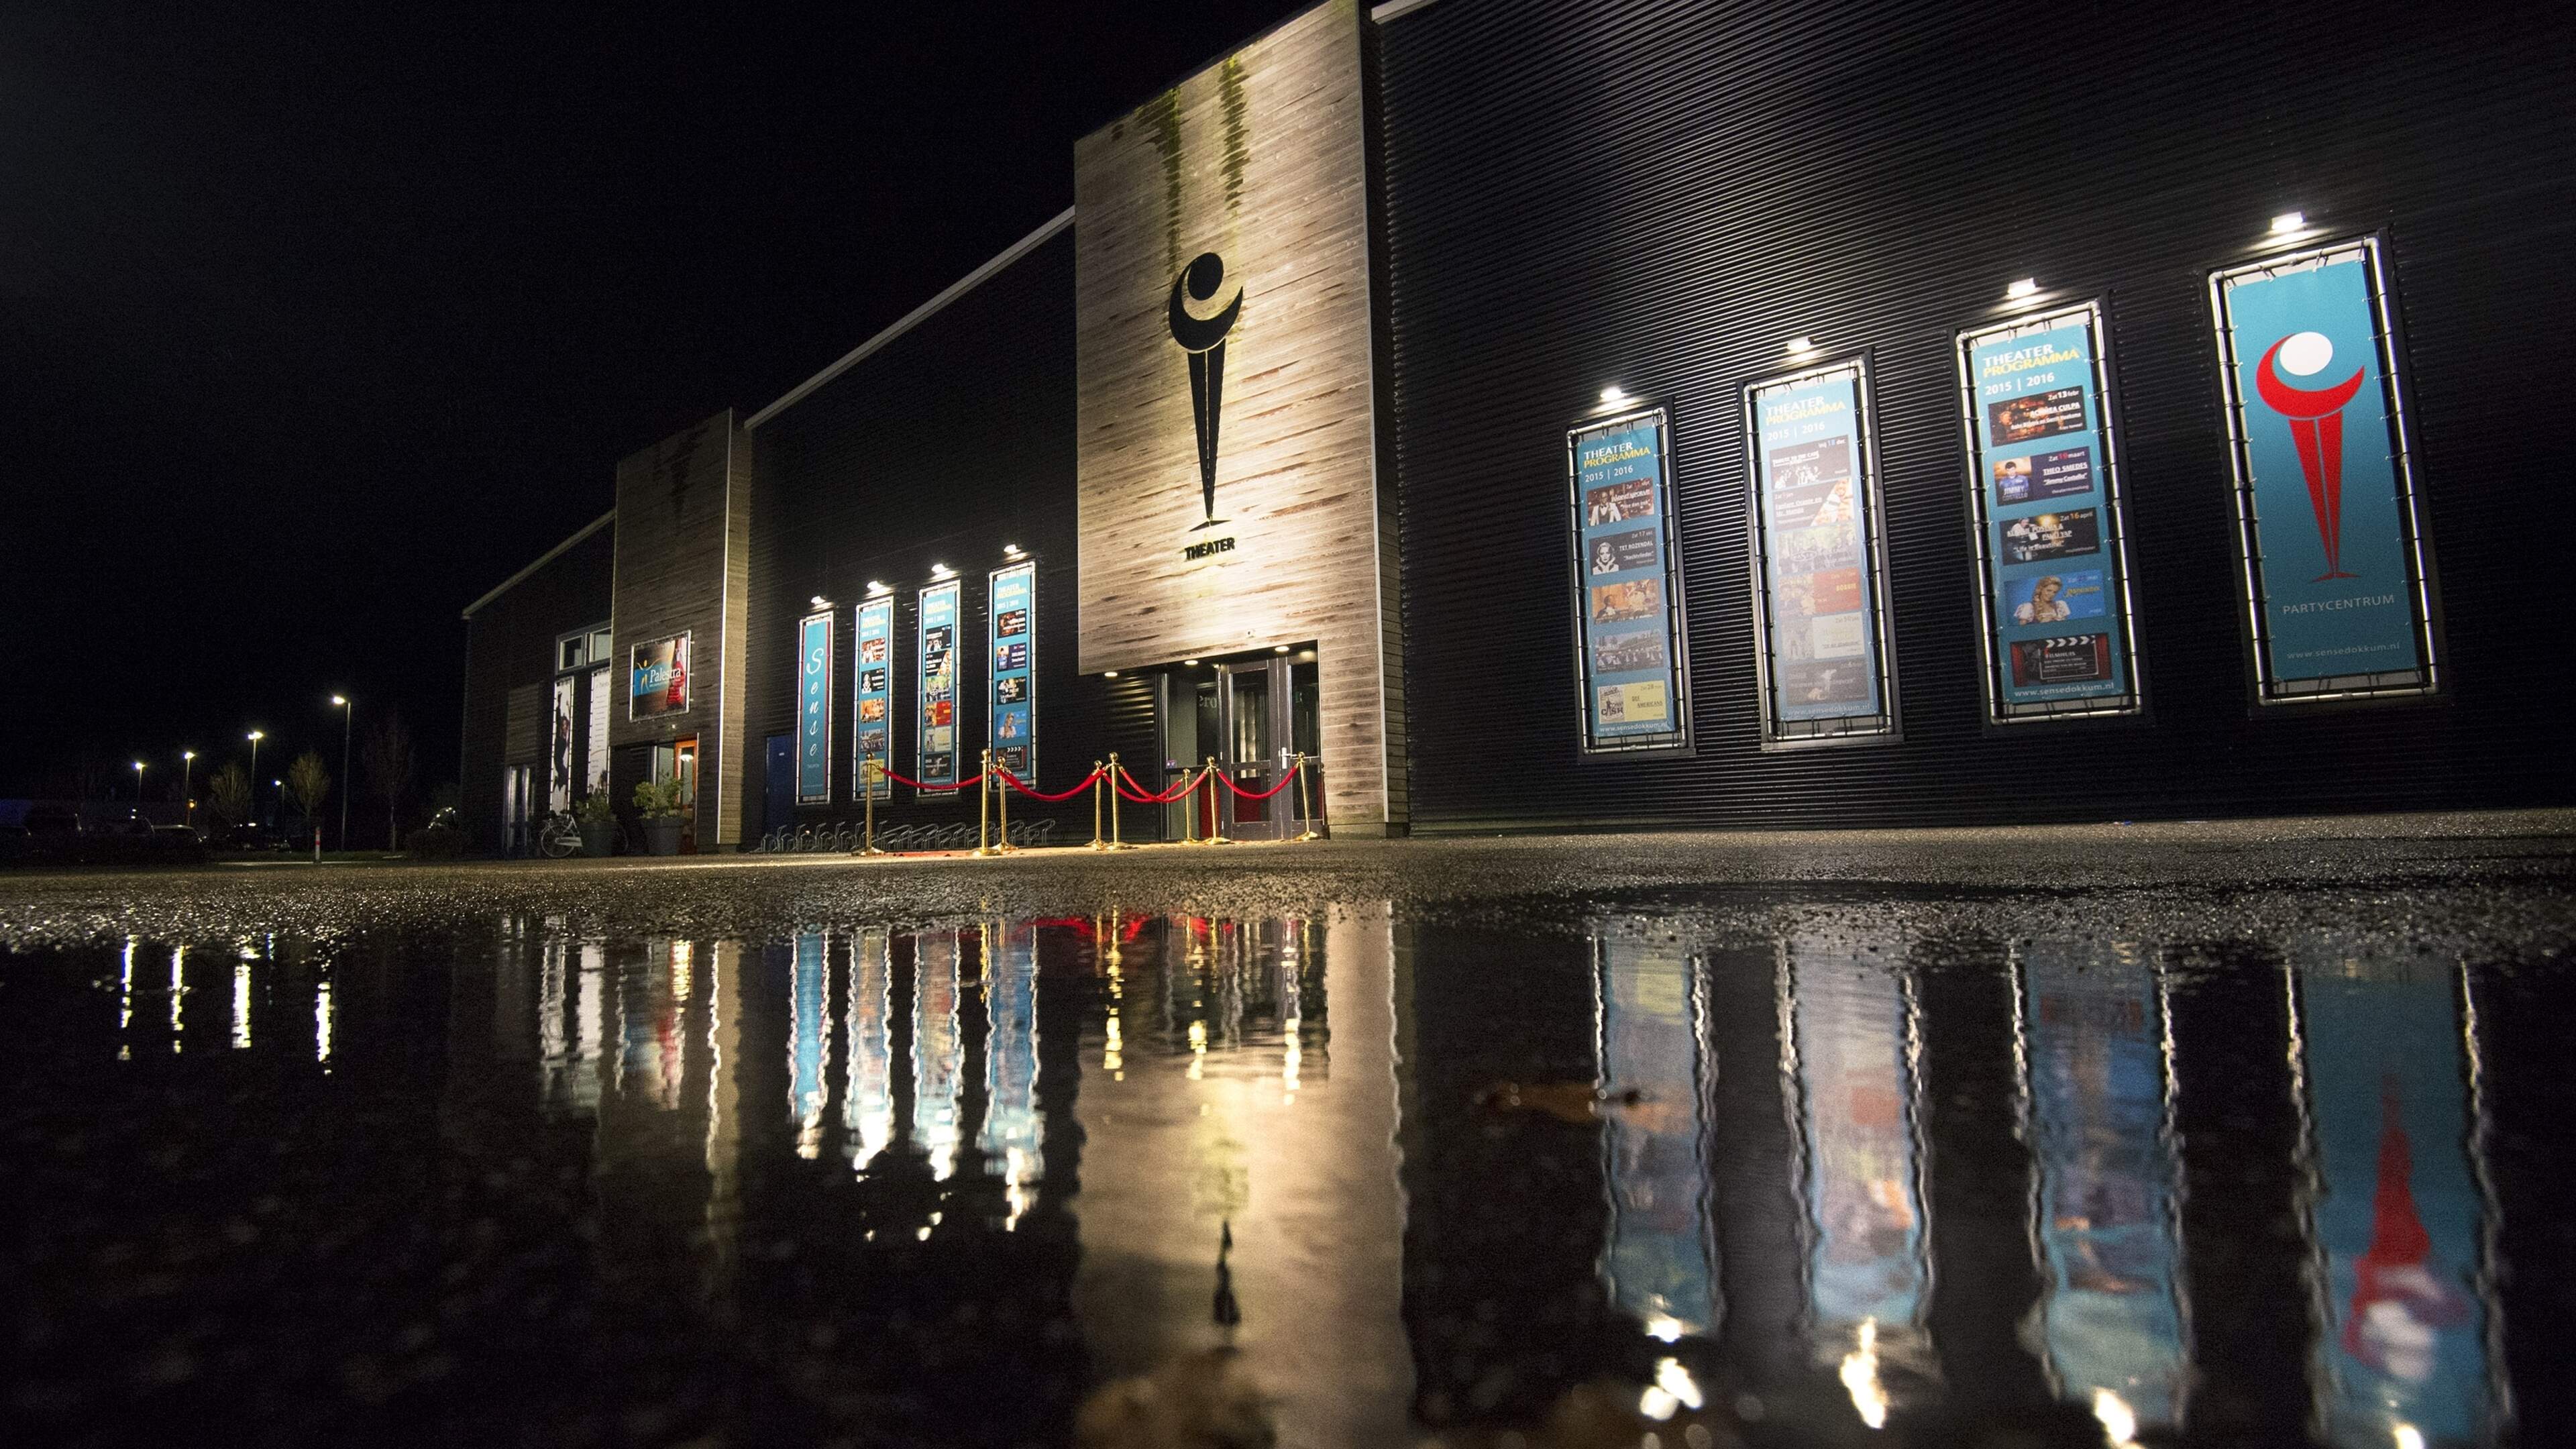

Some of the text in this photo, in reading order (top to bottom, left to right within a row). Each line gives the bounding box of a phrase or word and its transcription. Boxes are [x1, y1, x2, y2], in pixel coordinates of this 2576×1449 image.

[1982, 344, 2054, 368] THEATER
[1983, 348, 2080, 378] PROGRAMMA
[1985, 382, 2012, 396] 2015
[2027, 372, 2055, 387] 2016
[1766, 396, 1825, 417] THEATER
[1766, 400, 1846, 427] PROGRAMMA
[1767, 429, 1790, 441] 2015
[1803, 421, 1825, 435] 2016
[1584, 446, 1651, 468] PROGRAMMA
[1585, 442, 1633, 460] THEATER
[1585, 471, 1604, 482] 2015
[1614, 465, 1633, 476] 2016
[2043, 462, 2088, 476] THEO SMEDES
[1184, 537, 1235, 560] THEATER
[2283, 594, 2394, 614] PARTYCENTRUM
[2287, 641, 2400, 659] www.sensedokkum.nl
[649, 667, 682, 684] Palestra
[2014, 682, 2114, 697] www.sensedokkum.nl
[806, 647, 824, 757] Sense
[1599, 722, 1668, 733] www.sensedokkum.nl
